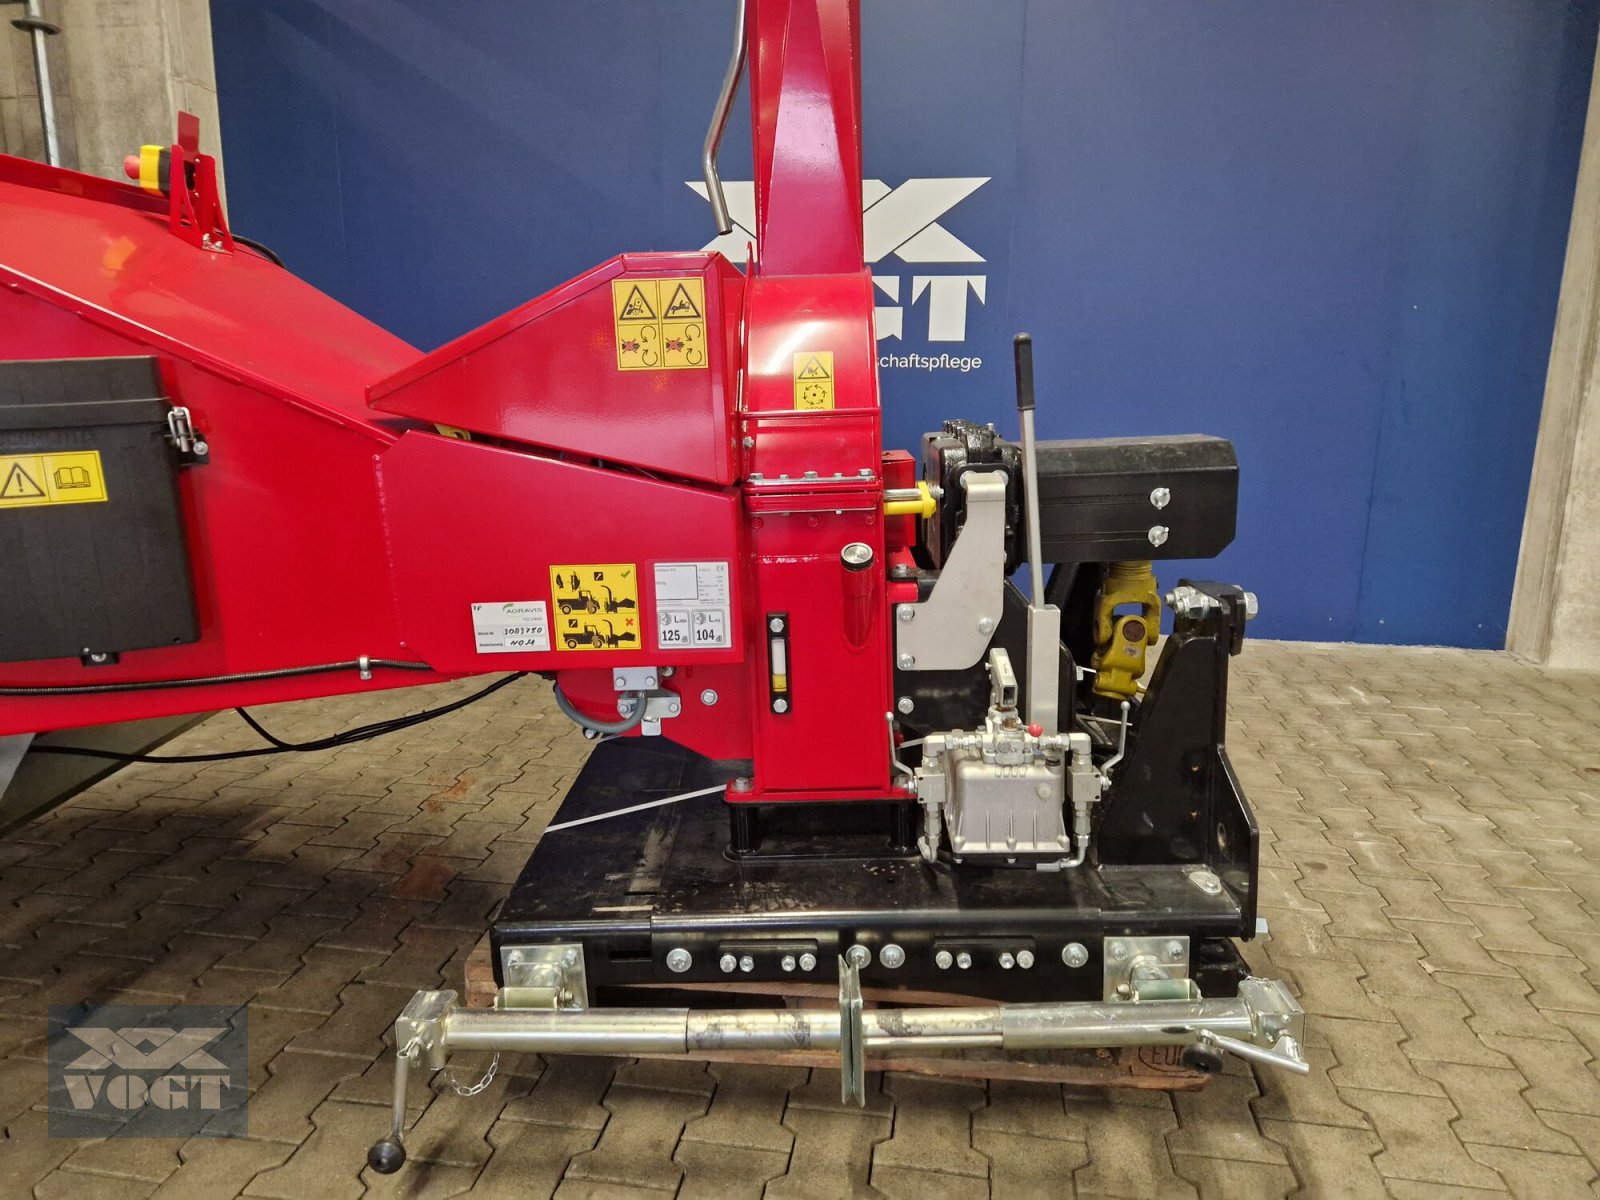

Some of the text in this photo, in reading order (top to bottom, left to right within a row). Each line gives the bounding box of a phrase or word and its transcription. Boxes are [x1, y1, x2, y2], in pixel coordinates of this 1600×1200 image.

[877, 353, 982, 372] chaftspflege
[662, 630, 680, 641] 125
[697, 629, 714, 640] 104
[1152, 1045, 1183, 1067] EU
